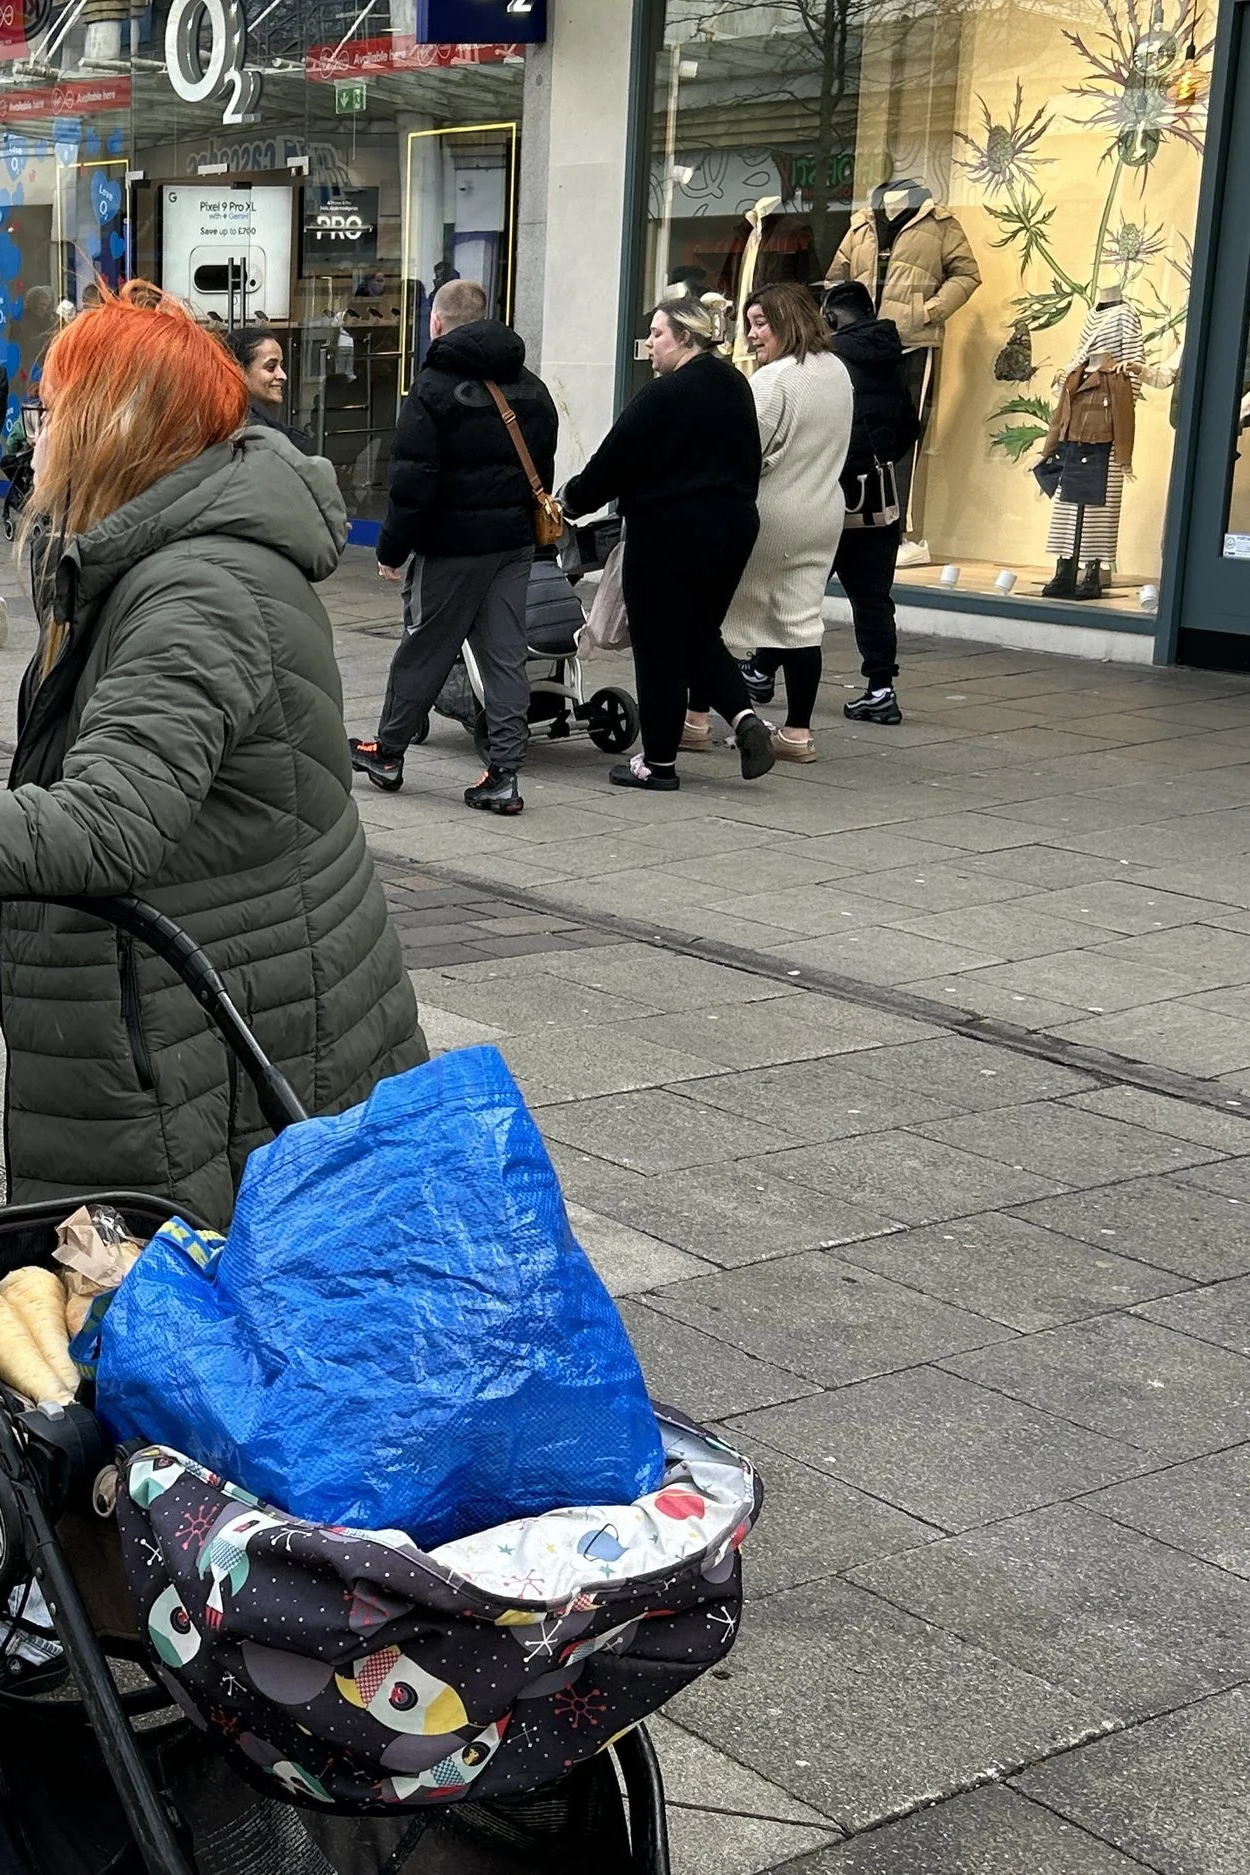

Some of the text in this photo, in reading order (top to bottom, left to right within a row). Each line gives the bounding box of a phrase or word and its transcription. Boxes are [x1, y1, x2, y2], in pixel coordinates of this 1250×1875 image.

[99, 184, 113, 201] Love
[200, 201, 257, 212] Pixel 9 Pro XL
[200, 227, 257, 238] Save up to £700
[316, 215, 362, 240] PRO
